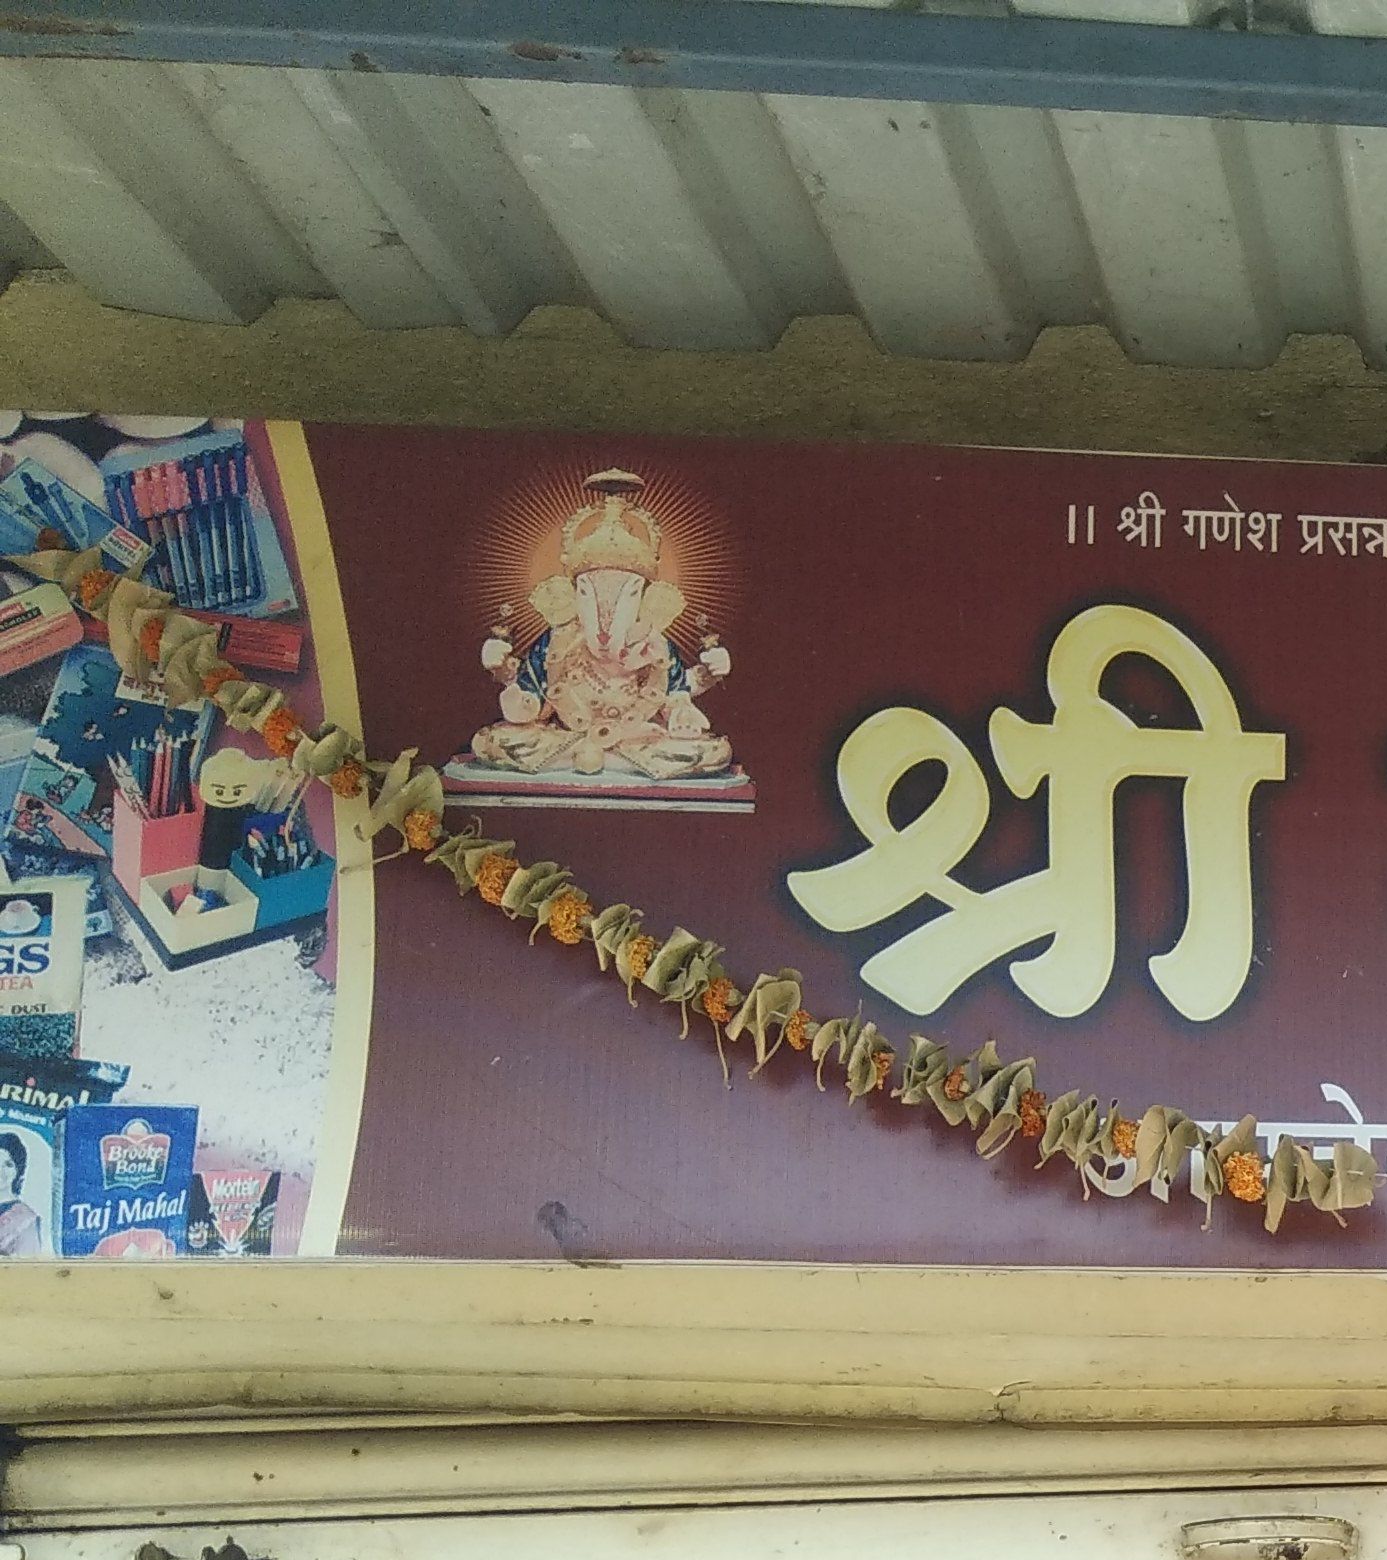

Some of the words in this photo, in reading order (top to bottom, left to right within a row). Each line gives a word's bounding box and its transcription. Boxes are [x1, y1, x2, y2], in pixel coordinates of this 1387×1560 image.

[1116, 491, 1166, 548] श्री
[1181, 493, 1282, 553] गणेश
[787, 603, 1286, 1022] श्री
[109, 1143, 164, 1163] Brooke
[115, 1158, 156, 1176] Bond
[70, 1202, 112, 1232] Taj
[118, 1190, 188, 1223] Mahal
